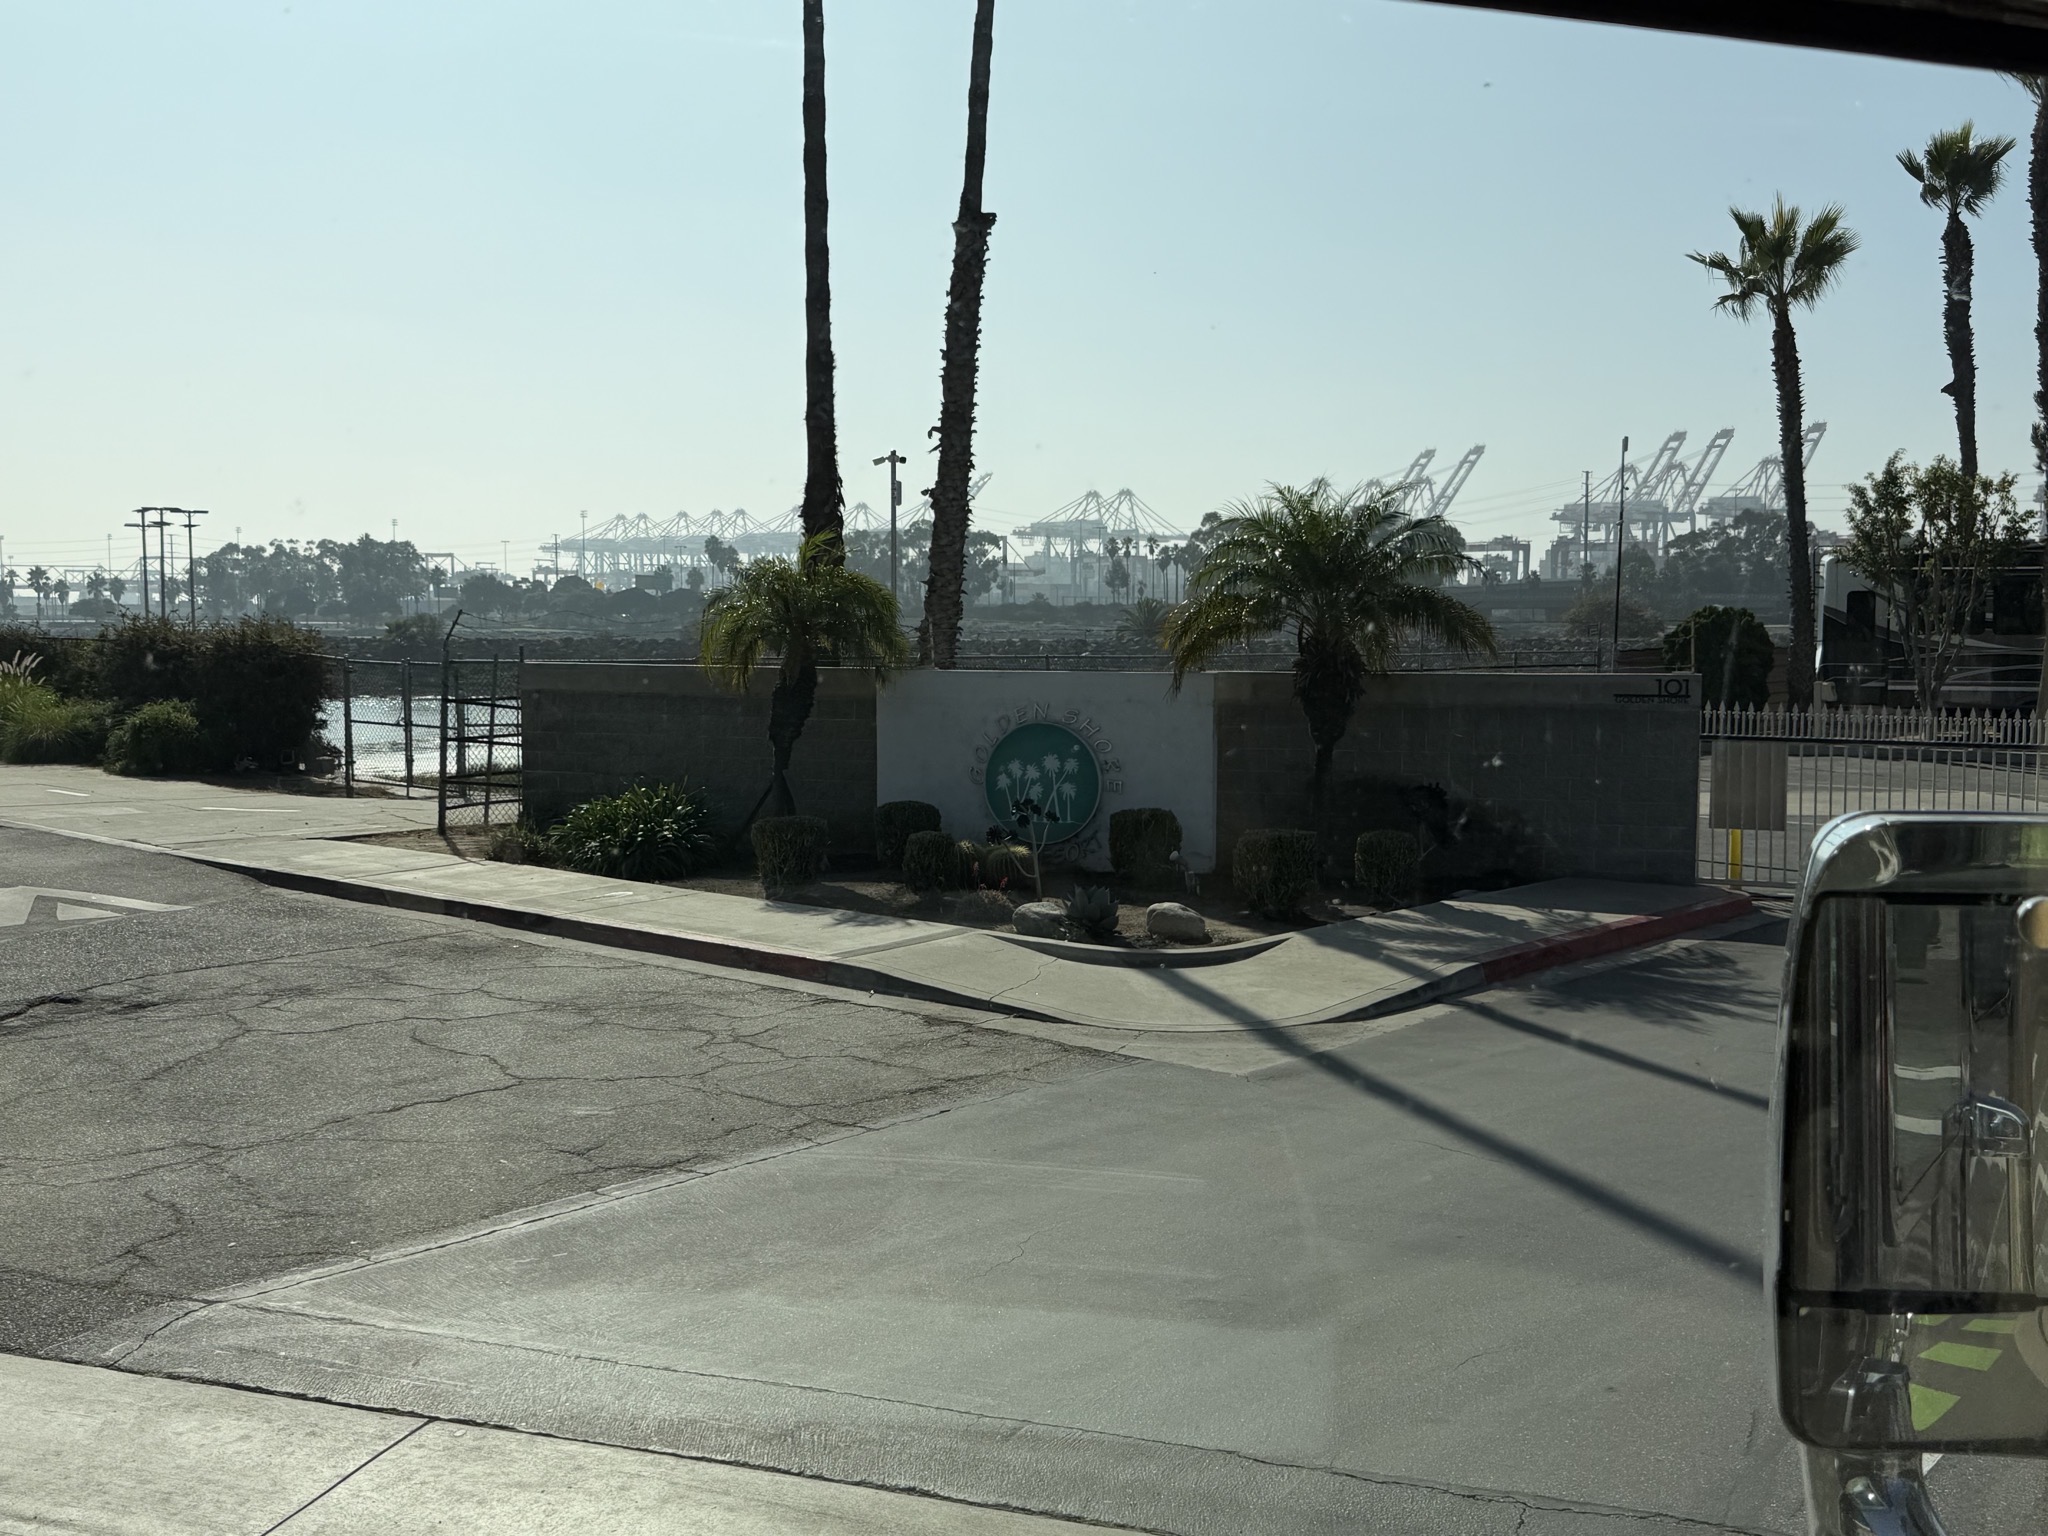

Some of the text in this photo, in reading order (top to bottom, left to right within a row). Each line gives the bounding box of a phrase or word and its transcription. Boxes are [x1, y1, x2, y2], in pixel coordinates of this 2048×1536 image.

[1654, 678, 1690, 696] 101
[1614, 696, 1690, 705] GOLDEN SHORE
[968, 702, 1124, 795] GOLDEN SHORE
